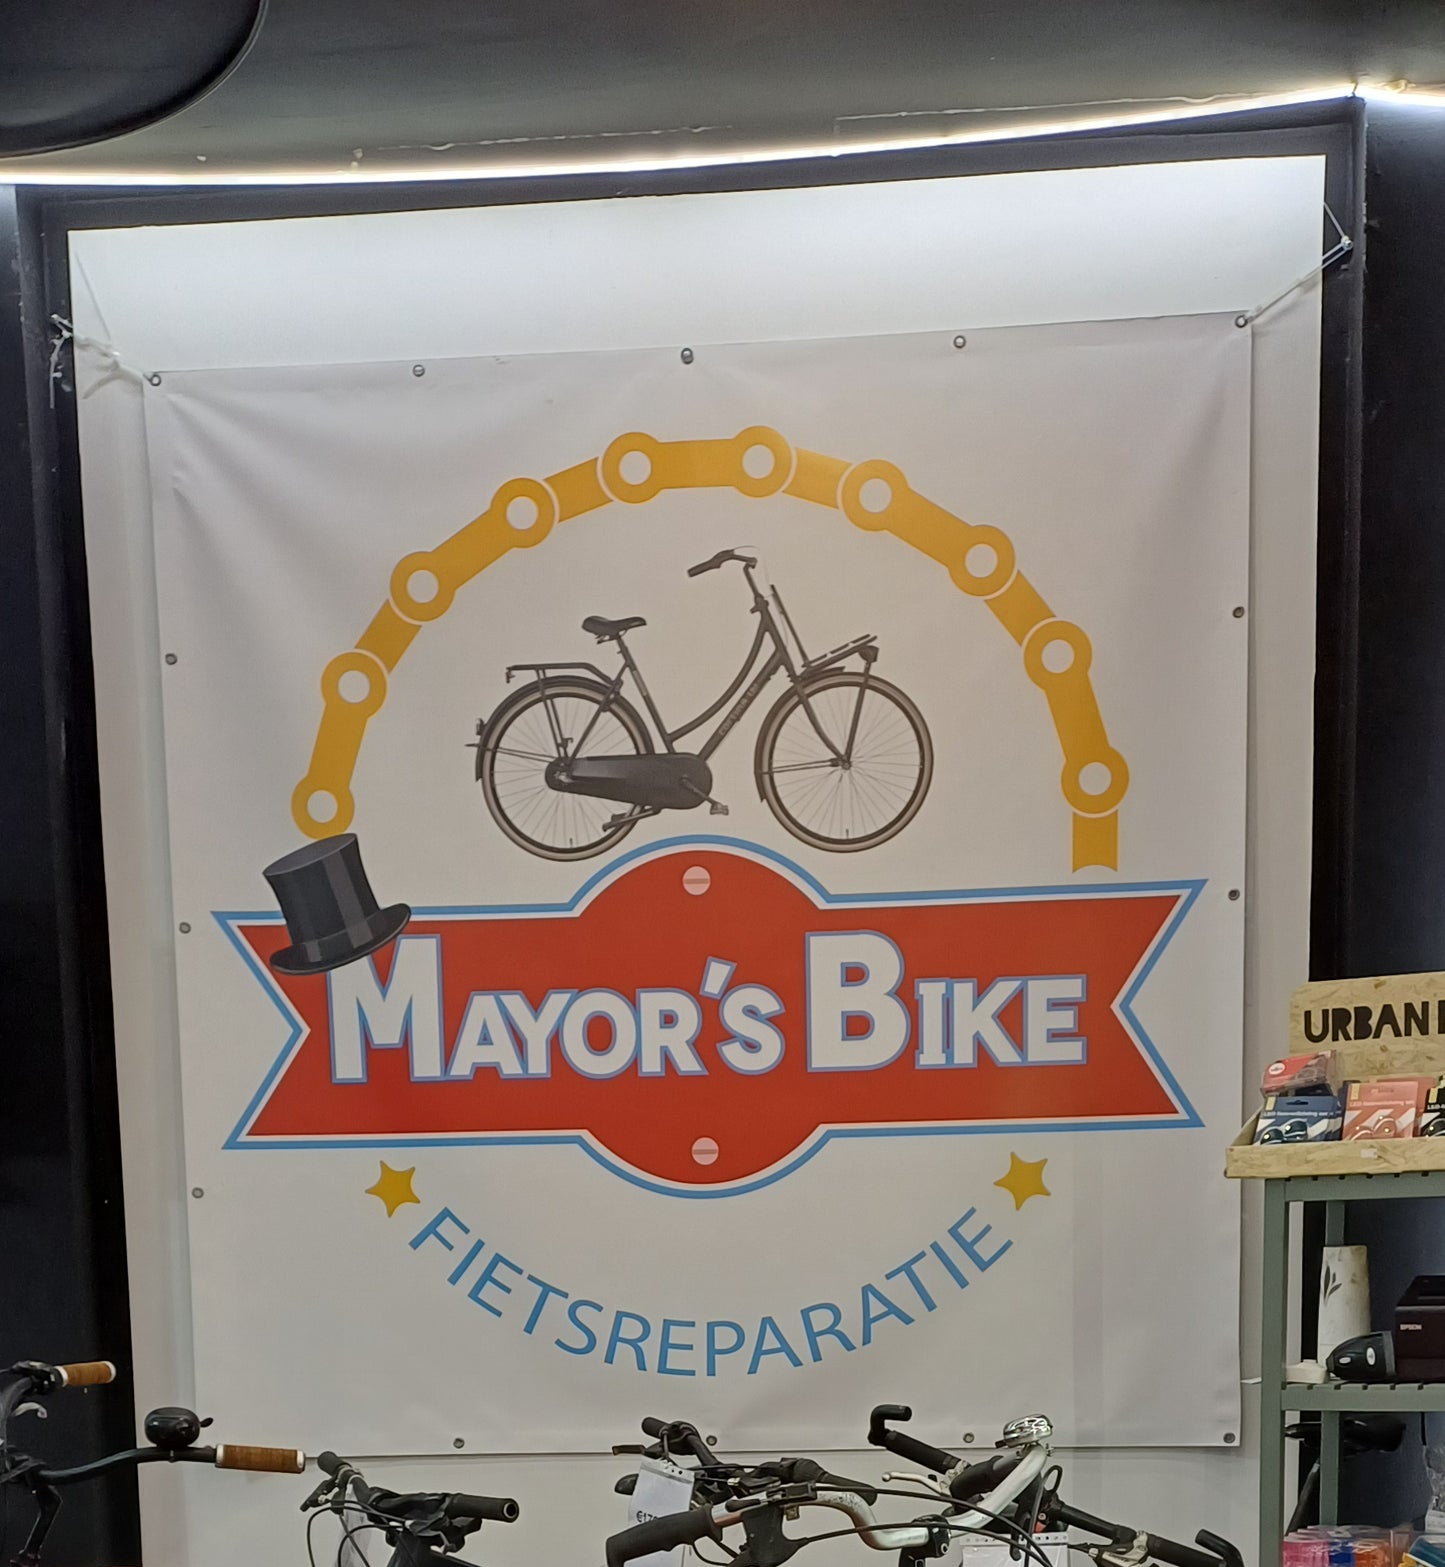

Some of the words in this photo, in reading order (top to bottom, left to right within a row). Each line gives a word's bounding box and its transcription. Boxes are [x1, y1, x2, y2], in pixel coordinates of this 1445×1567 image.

[804, 929, 1088, 1073] BIKE
[1304, 1001, 1429, 1043] URBAN
[409, 1205, 1013, 1377] FIETSREPARATIE
[636, 1510, 658, 1523] €17
